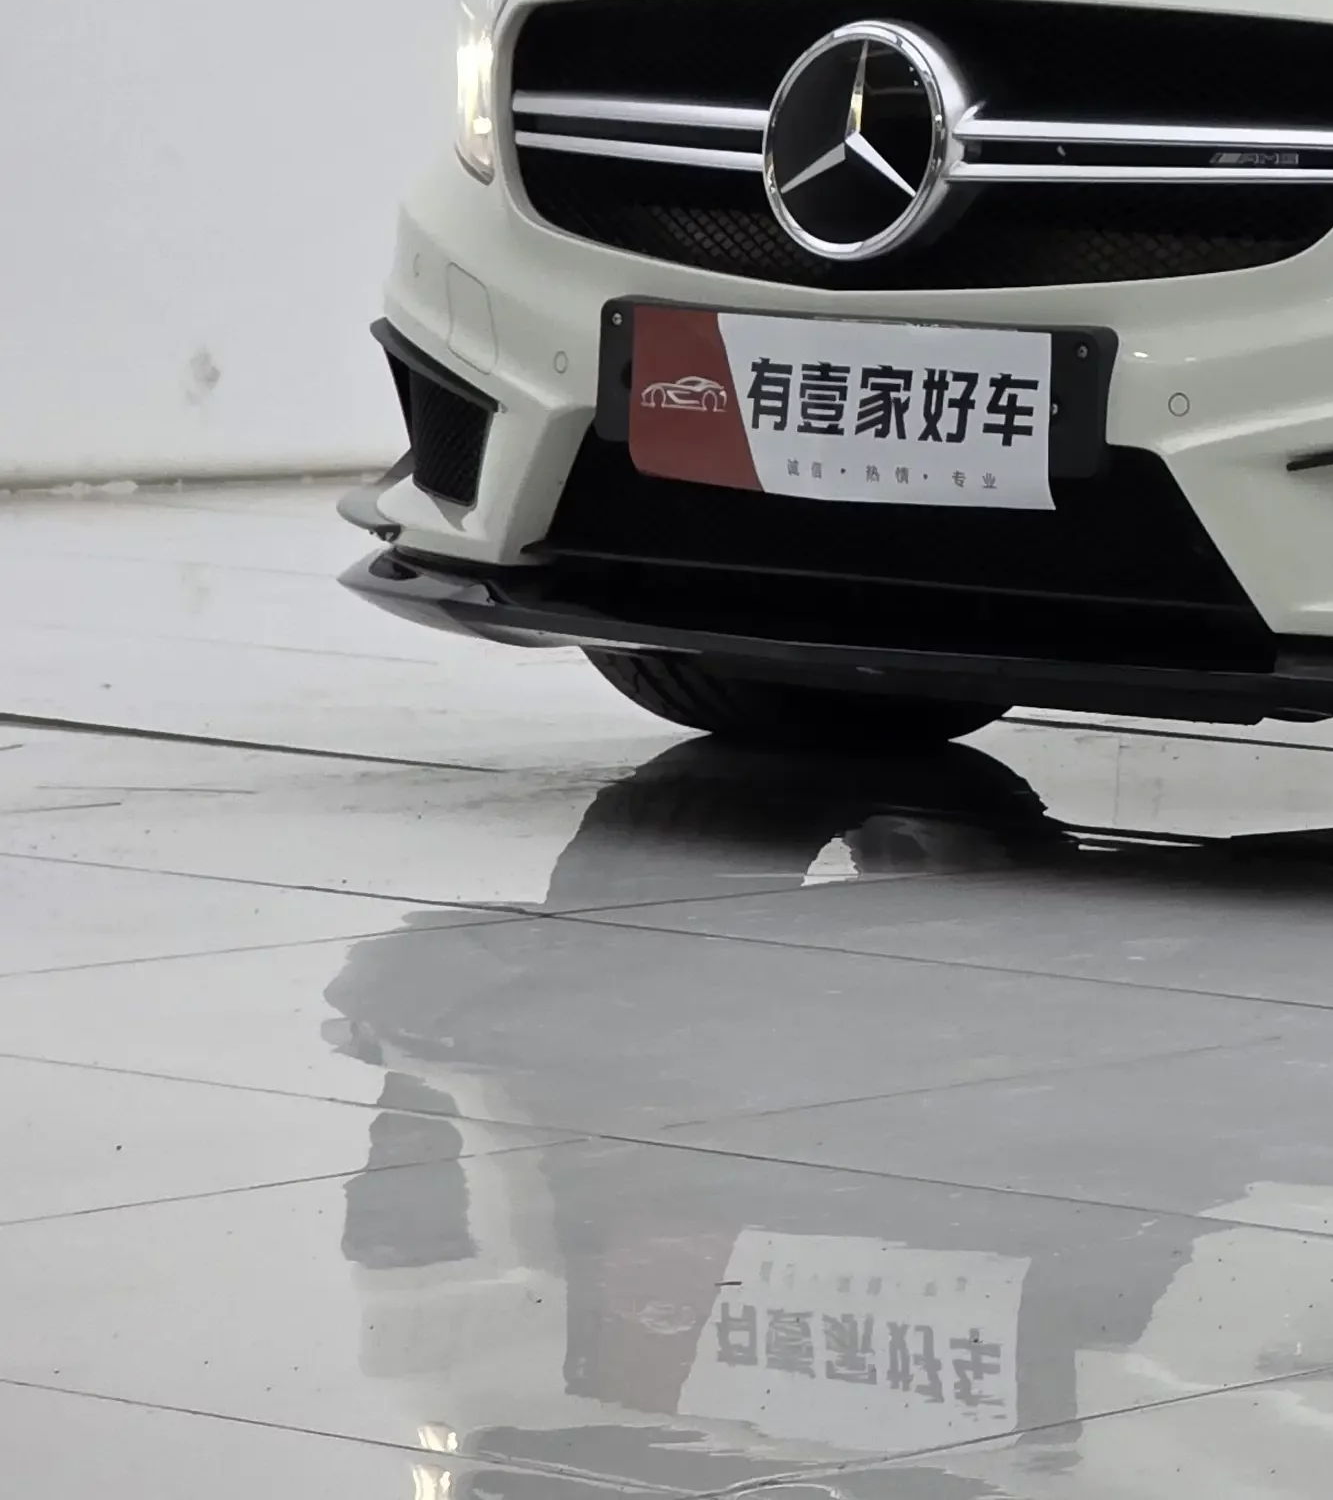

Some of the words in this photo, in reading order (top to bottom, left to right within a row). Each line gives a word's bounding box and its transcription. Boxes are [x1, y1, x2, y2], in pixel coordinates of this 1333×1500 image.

[746, 356, 1040, 447] 有壹家好车
